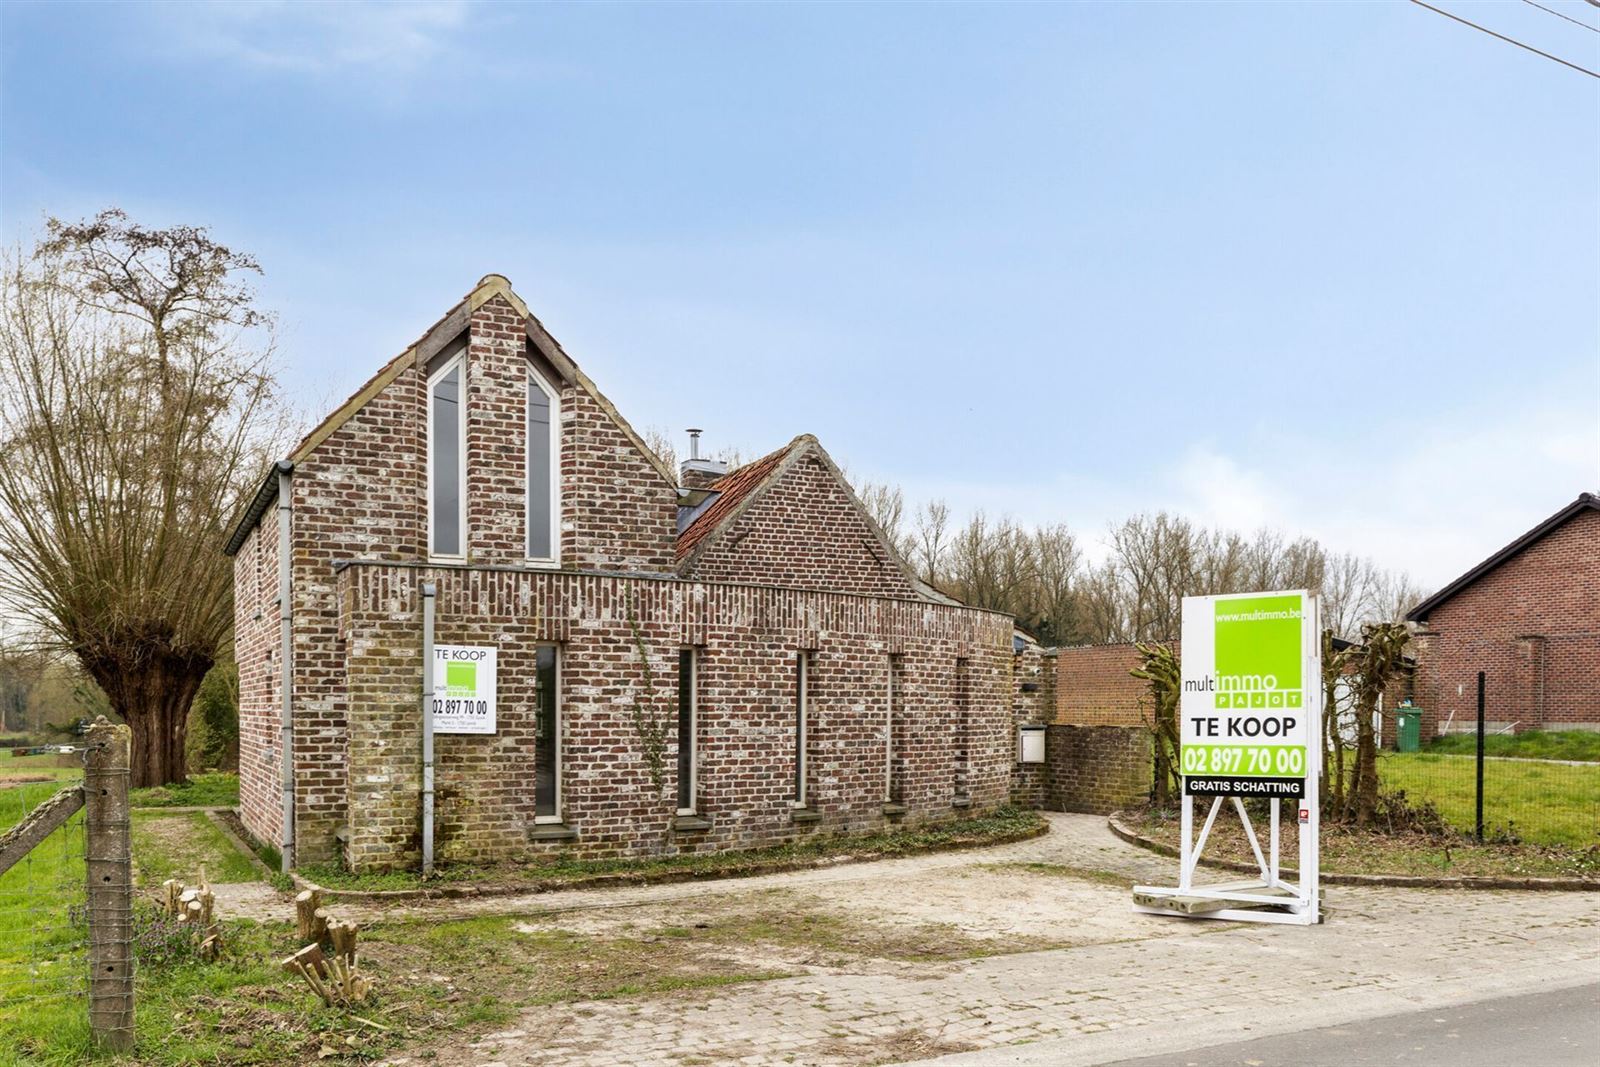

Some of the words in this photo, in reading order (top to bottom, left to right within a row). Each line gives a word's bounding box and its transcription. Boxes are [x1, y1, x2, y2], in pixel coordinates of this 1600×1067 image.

[1215, 608, 1301, 622] www.multimmo.be
[435, 649, 448, 660] TE
[452, 650, 487, 661] KOOP
[433, 699, 443, 714] 02
[445, 700, 461, 714] 897
[464, 700, 474, 714] 70
[476, 700, 488, 715] 00
[1218, 695, 1298, 705] PAJOT
[1191, 717, 1219, 737] TE
[1227, 717, 1297, 737] KOOP
[1184, 747, 1207, 772] 02
[1211, 748, 1243, 773] 897
[1247, 748, 1271, 773] 70
[1276, 748, 1302, 774] 00
[1190, 780, 1231, 791] GRATIS
[1233, 781, 1300, 793] SCHATTING
